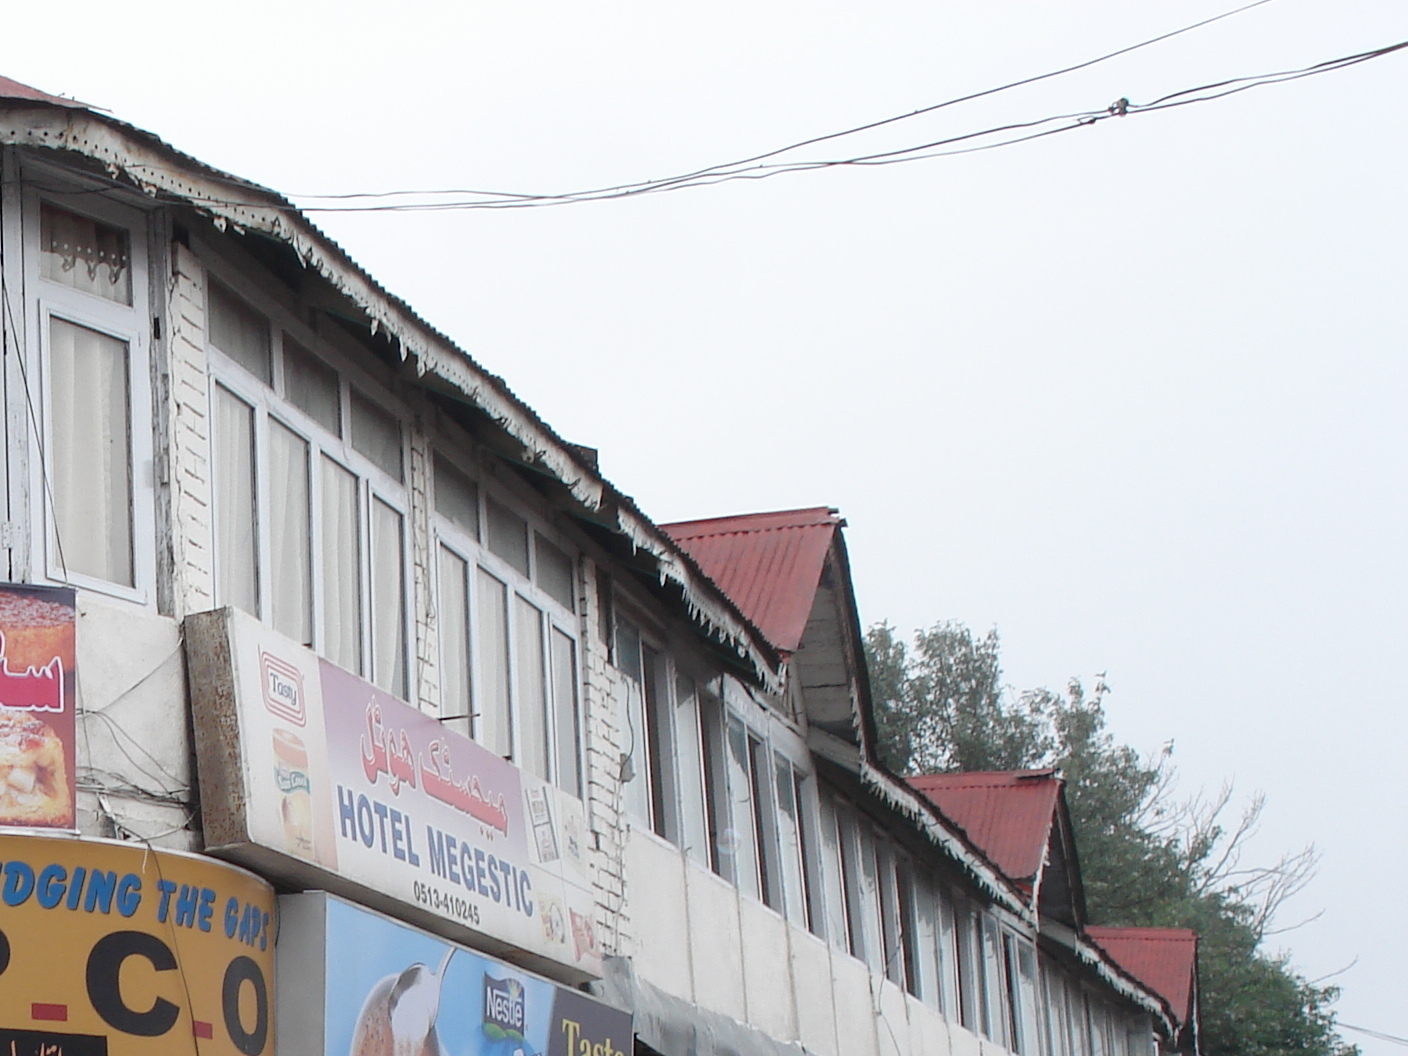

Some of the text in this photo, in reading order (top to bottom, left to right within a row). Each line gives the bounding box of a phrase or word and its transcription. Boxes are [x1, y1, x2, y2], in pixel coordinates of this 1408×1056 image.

[270, 672, 297, 705] Tasty
[337, 784, 420, 868] HOTEL
[426, 824, 534, 917] MEGESTIC
[157, 879, 216, 932] THE
[224, 896, 269, 951] GAPS
[413, 880, 480, 926] 0513-410245
